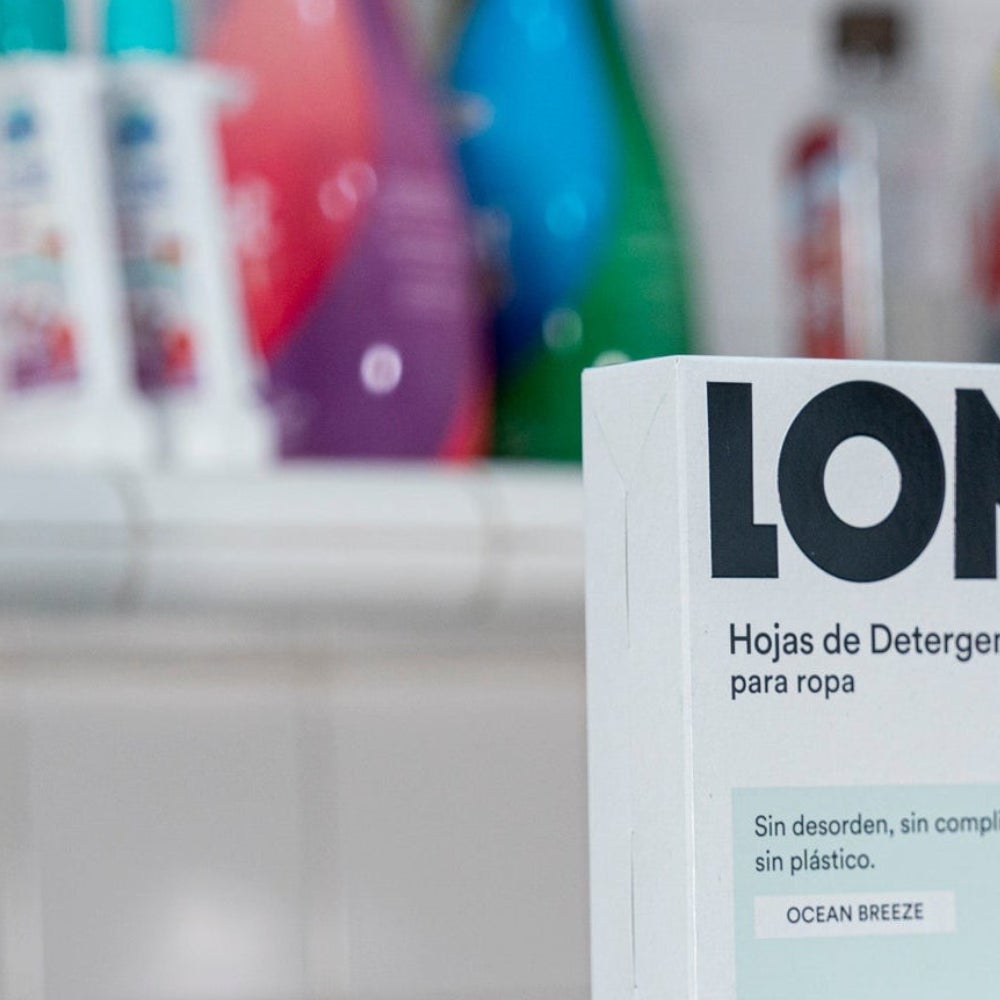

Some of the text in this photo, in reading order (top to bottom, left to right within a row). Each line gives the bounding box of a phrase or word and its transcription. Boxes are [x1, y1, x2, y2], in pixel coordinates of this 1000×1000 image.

[730, 622, 814, 663] Hojas
[823, 622, 860, 654] de
[731, 674, 855, 700] para ropa
[754, 815, 786, 837] Sin
[792, 813, 895, 838] desorden,
[900, 811, 929, 834] sin
[755, 847, 876, 876] sin plástico.
[786, 902, 924, 924] OCEAN BREEZE
